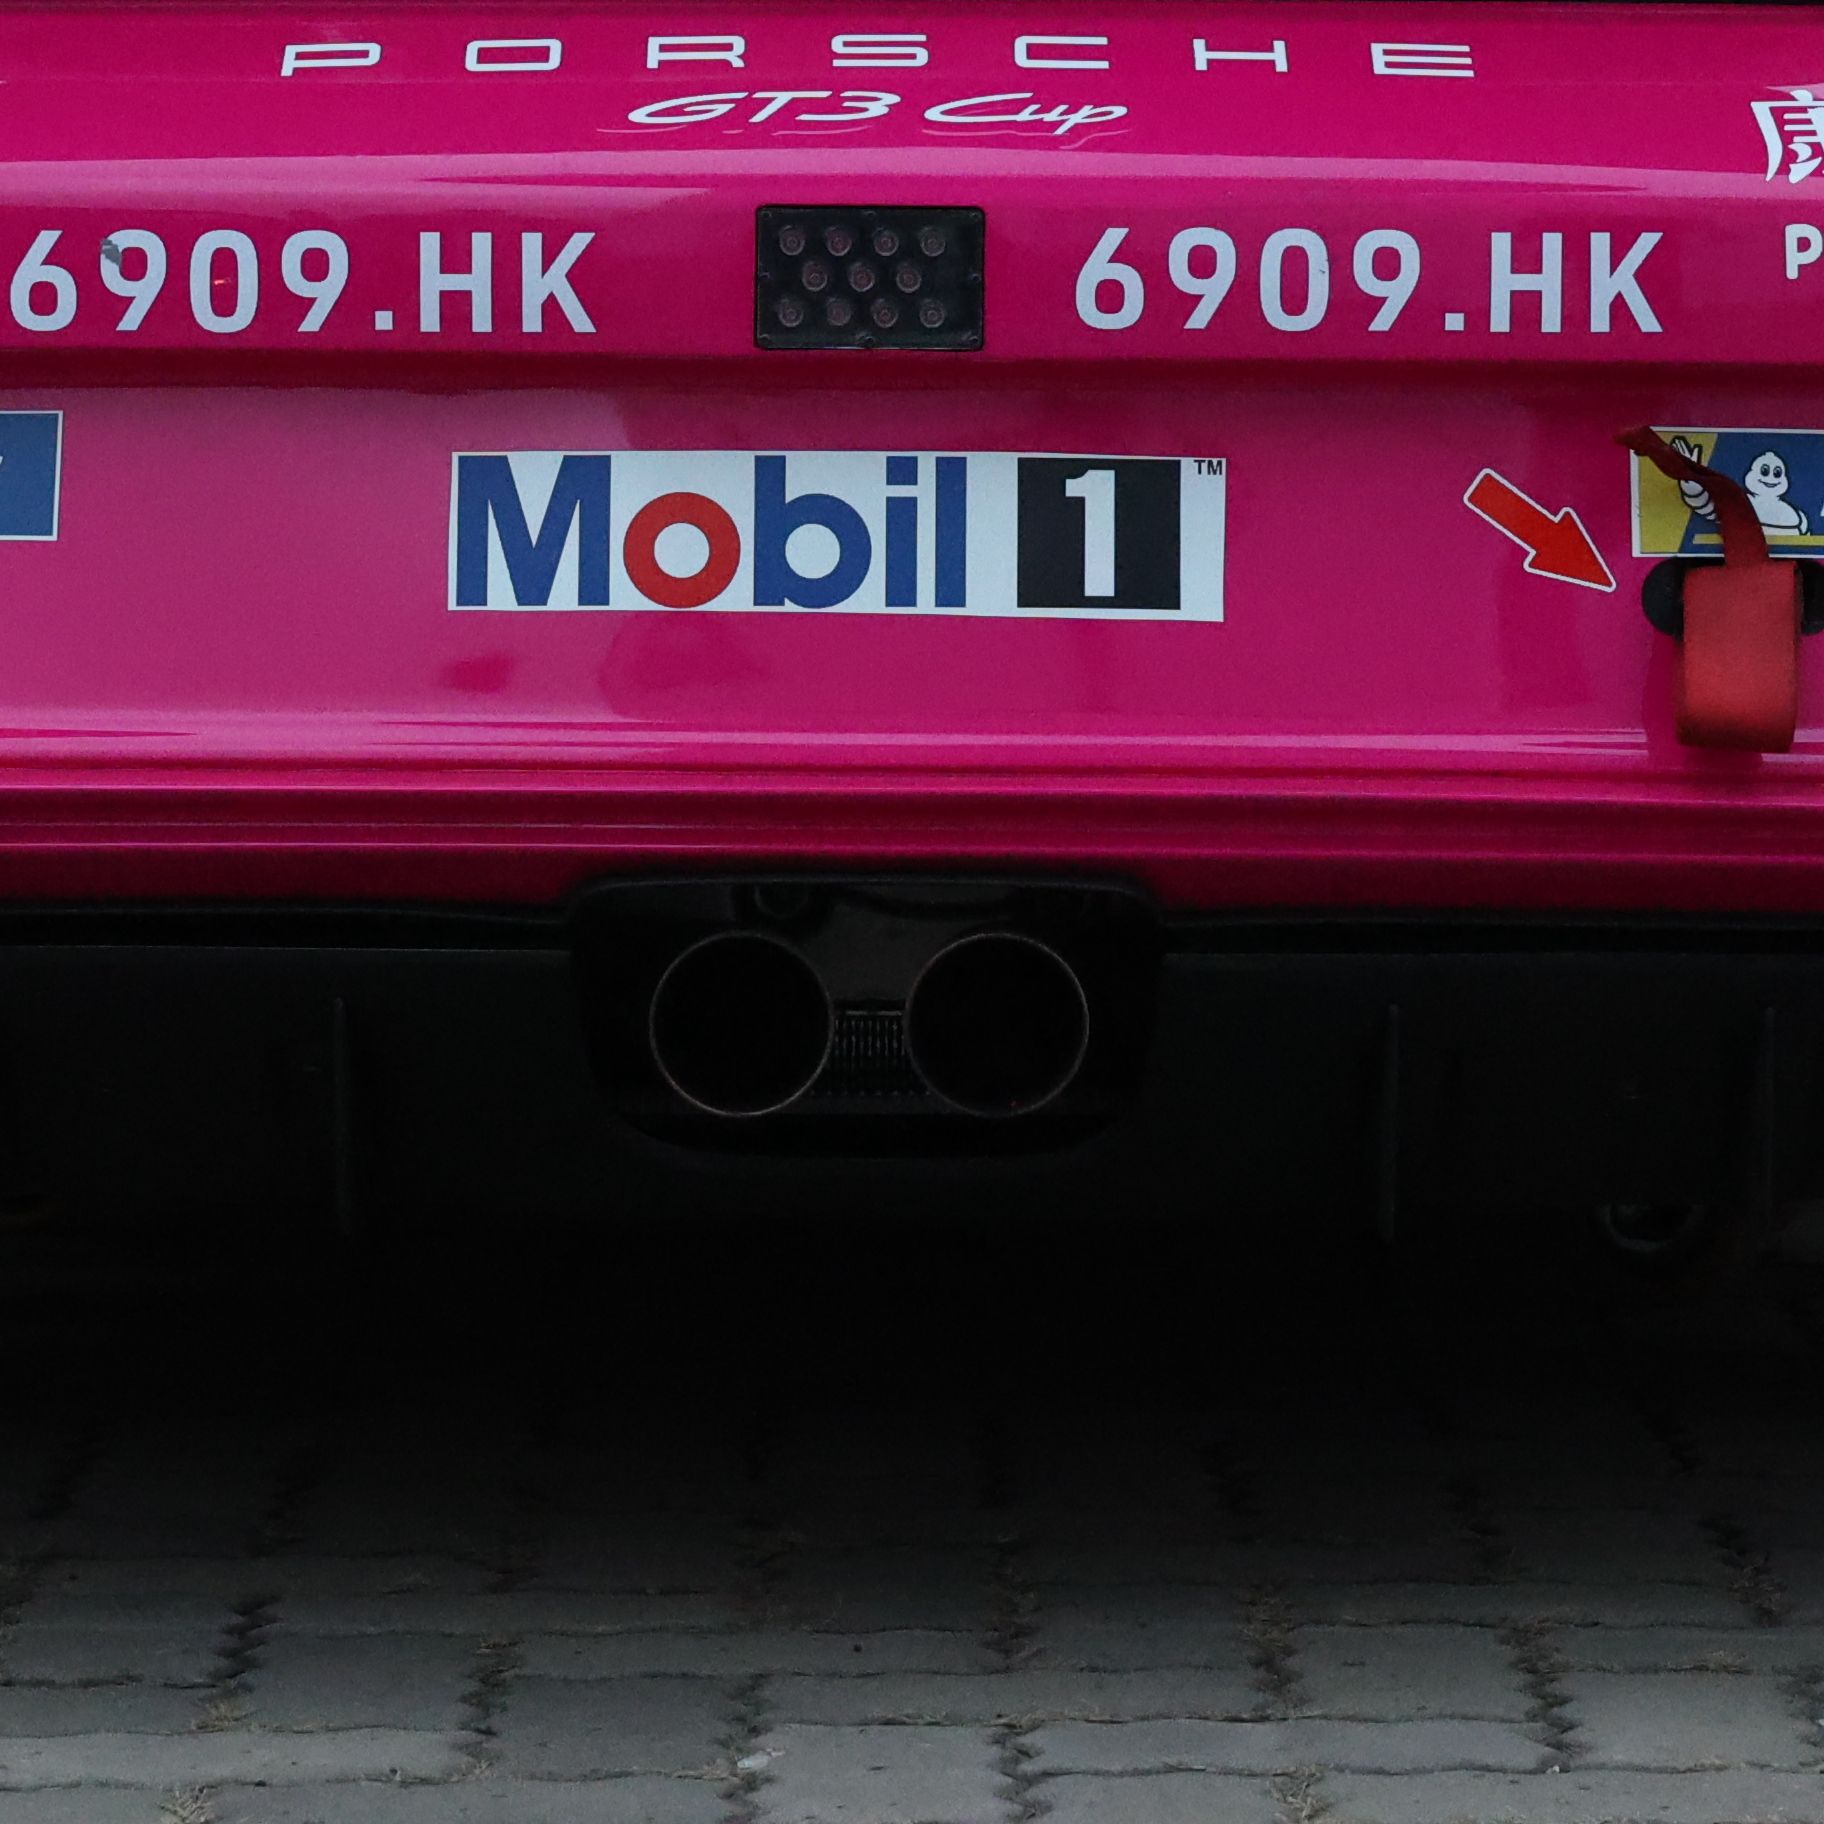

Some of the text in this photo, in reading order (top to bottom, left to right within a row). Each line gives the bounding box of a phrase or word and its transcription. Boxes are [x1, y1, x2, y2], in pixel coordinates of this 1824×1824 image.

[281, 34, 1474, 77] PORSCHE
[627, 90, 1129, 135] GT3 Cup
[10, 229, 596, 333] 6909.HK
[1076, 227, 1663, 333] 6909.HK
[456, 454, 968, 610] Mobil
[1065, 469, 1115, 597] 1
